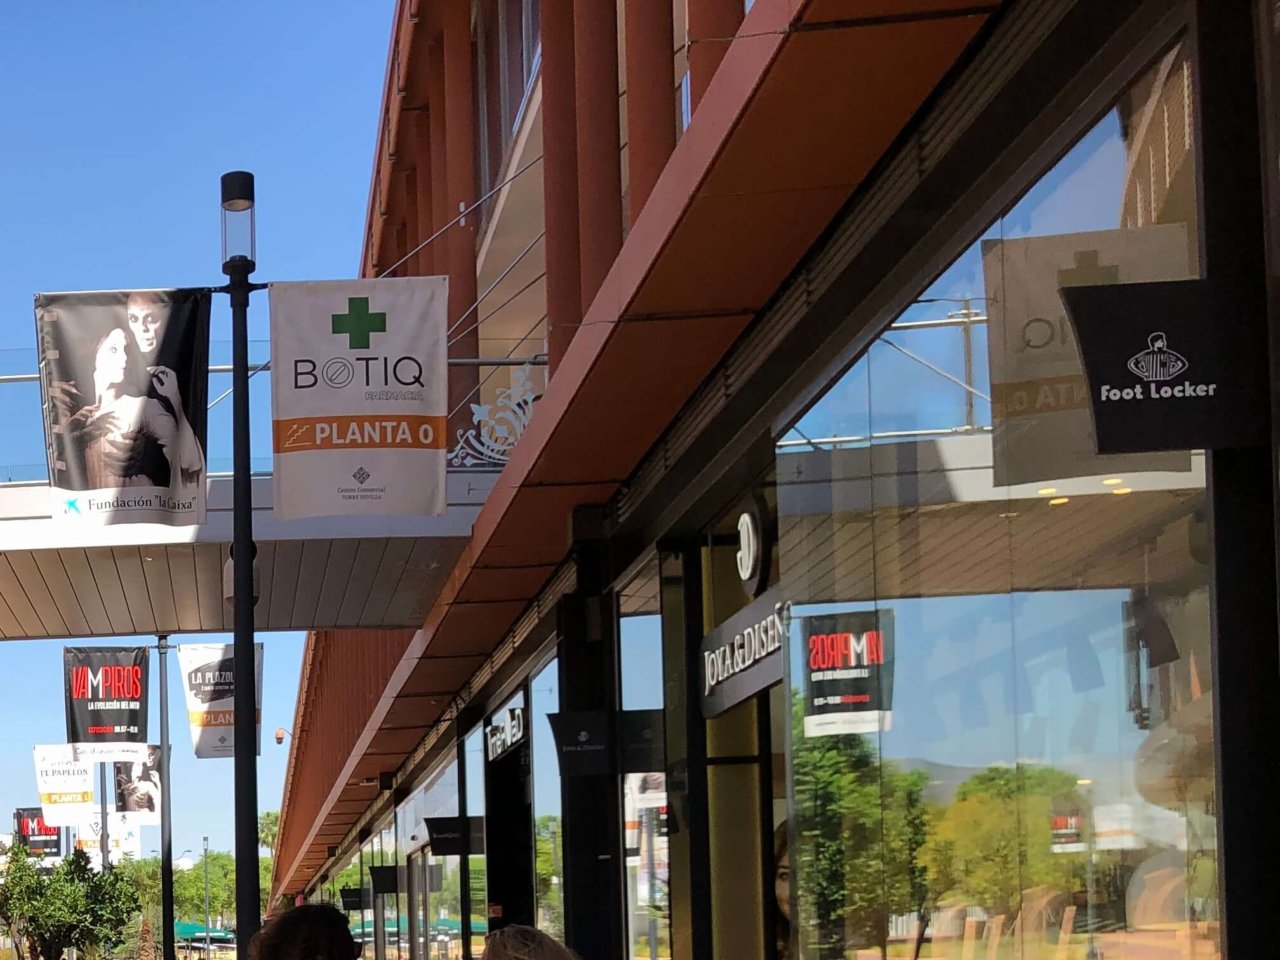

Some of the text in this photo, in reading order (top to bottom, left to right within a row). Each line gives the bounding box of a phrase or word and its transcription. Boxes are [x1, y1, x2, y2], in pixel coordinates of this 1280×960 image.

[364, 390, 424, 401] FARMACIA
[1100, 381, 1217, 401] Foot Locker
[315, 421, 434, 445] PLANTA 0
[88, 495, 152, 511] Fundación
[72, 665, 142, 699] VAMPIROS
[191, 672, 202, 684] LA
[203, 712, 234, 725] PLAN
